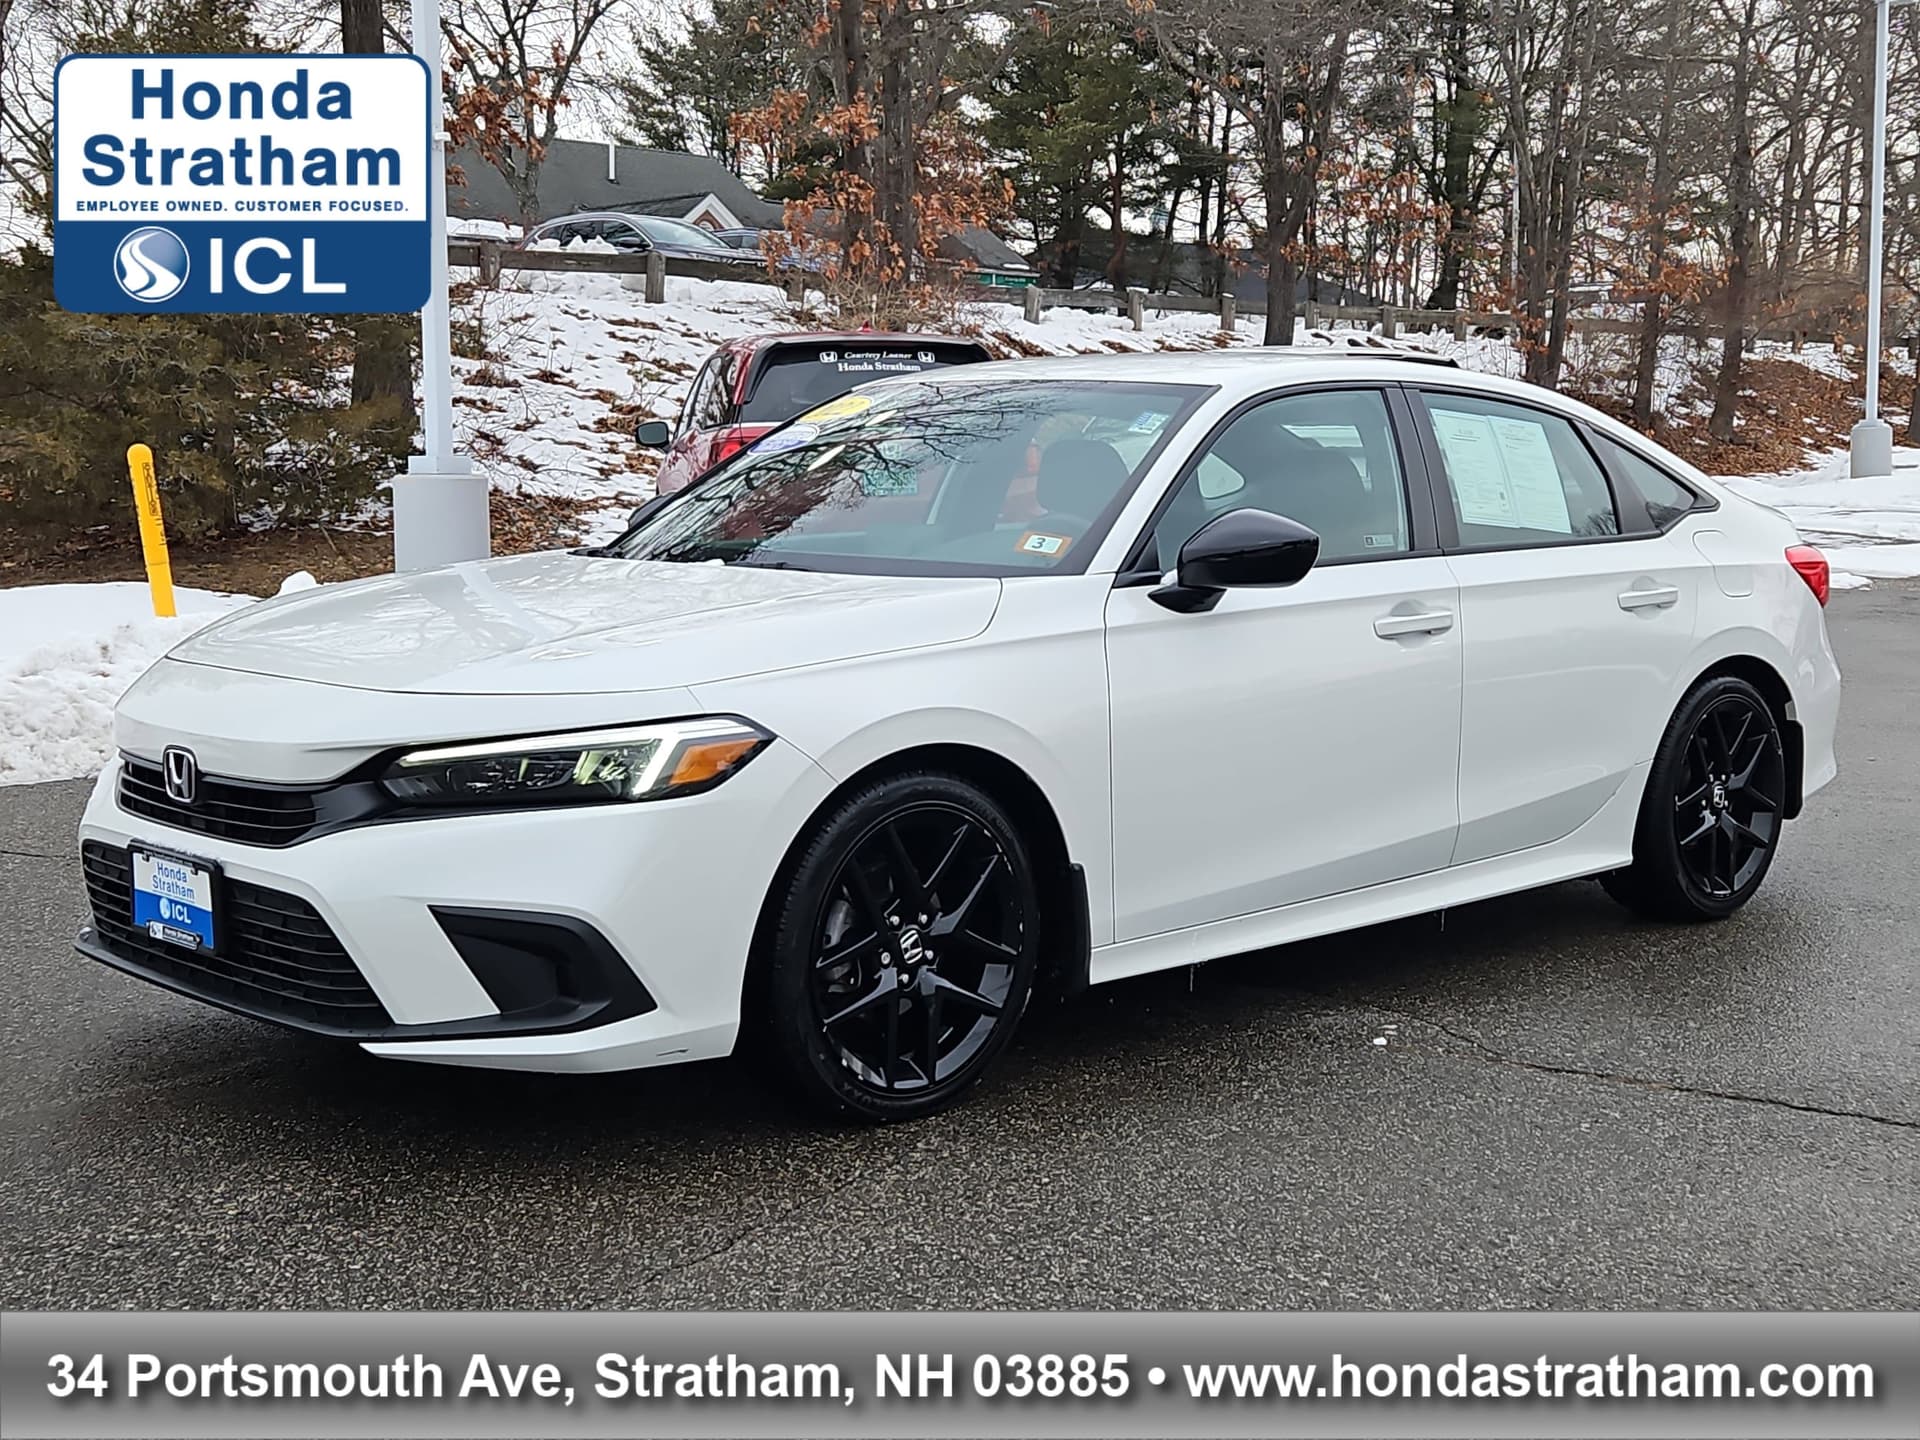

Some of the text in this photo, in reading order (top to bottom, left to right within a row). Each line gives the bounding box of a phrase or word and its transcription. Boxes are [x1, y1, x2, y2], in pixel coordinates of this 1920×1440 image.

[838, 361, 921, 372] Honda Stratham
[1032, 537, 1046, 549] 3
[157, 862, 187, 883] Honda
[152, 874, 195, 899] Stratham
[172, 903, 192, 924] ICL
